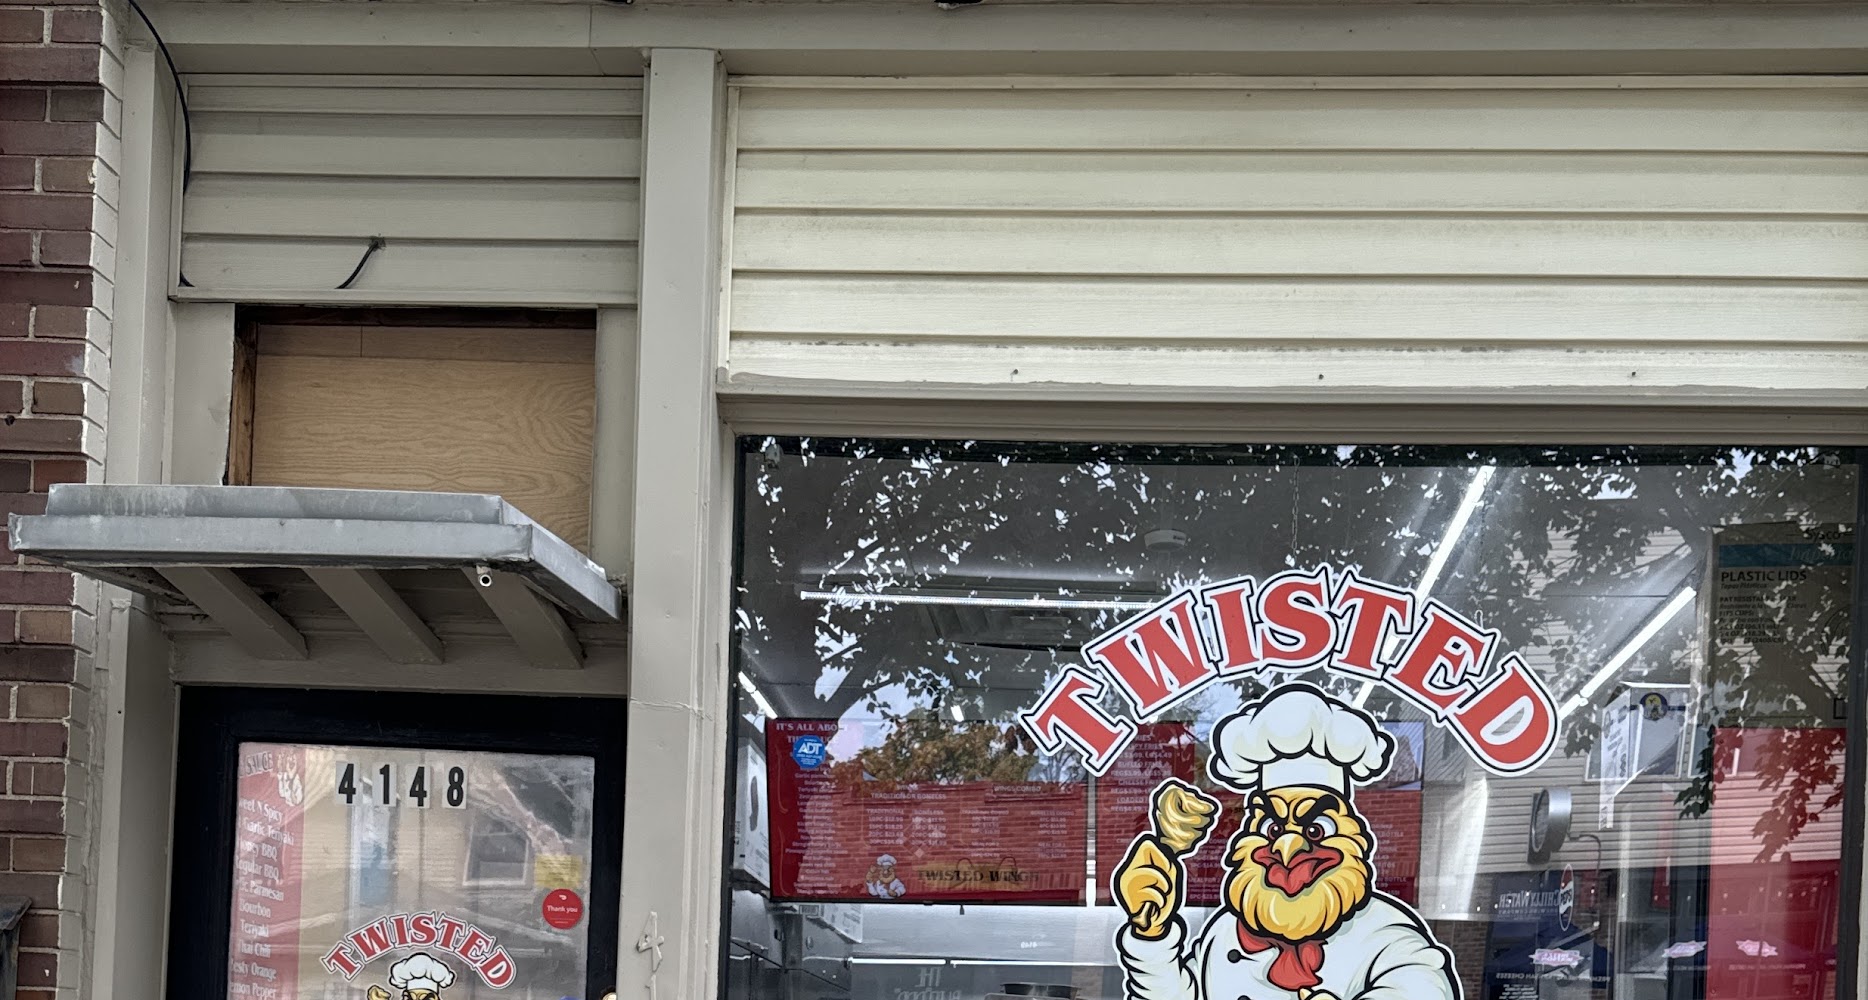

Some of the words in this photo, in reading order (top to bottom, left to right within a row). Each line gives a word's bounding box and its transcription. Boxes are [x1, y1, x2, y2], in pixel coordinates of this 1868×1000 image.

[1721, 571, 1776, 582] PLASTIC
[1778, 570, 1807, 581] LIDS
[1026, 572, 1556, 771] TWISTED
[797, 723, 815, 731] ALL
[798, 742, 823, 755] ADT
[338, 763, 465, 807] 4148
[323, 912, 515, 988] TWISTED
[230, 982, 250, 996] emon
